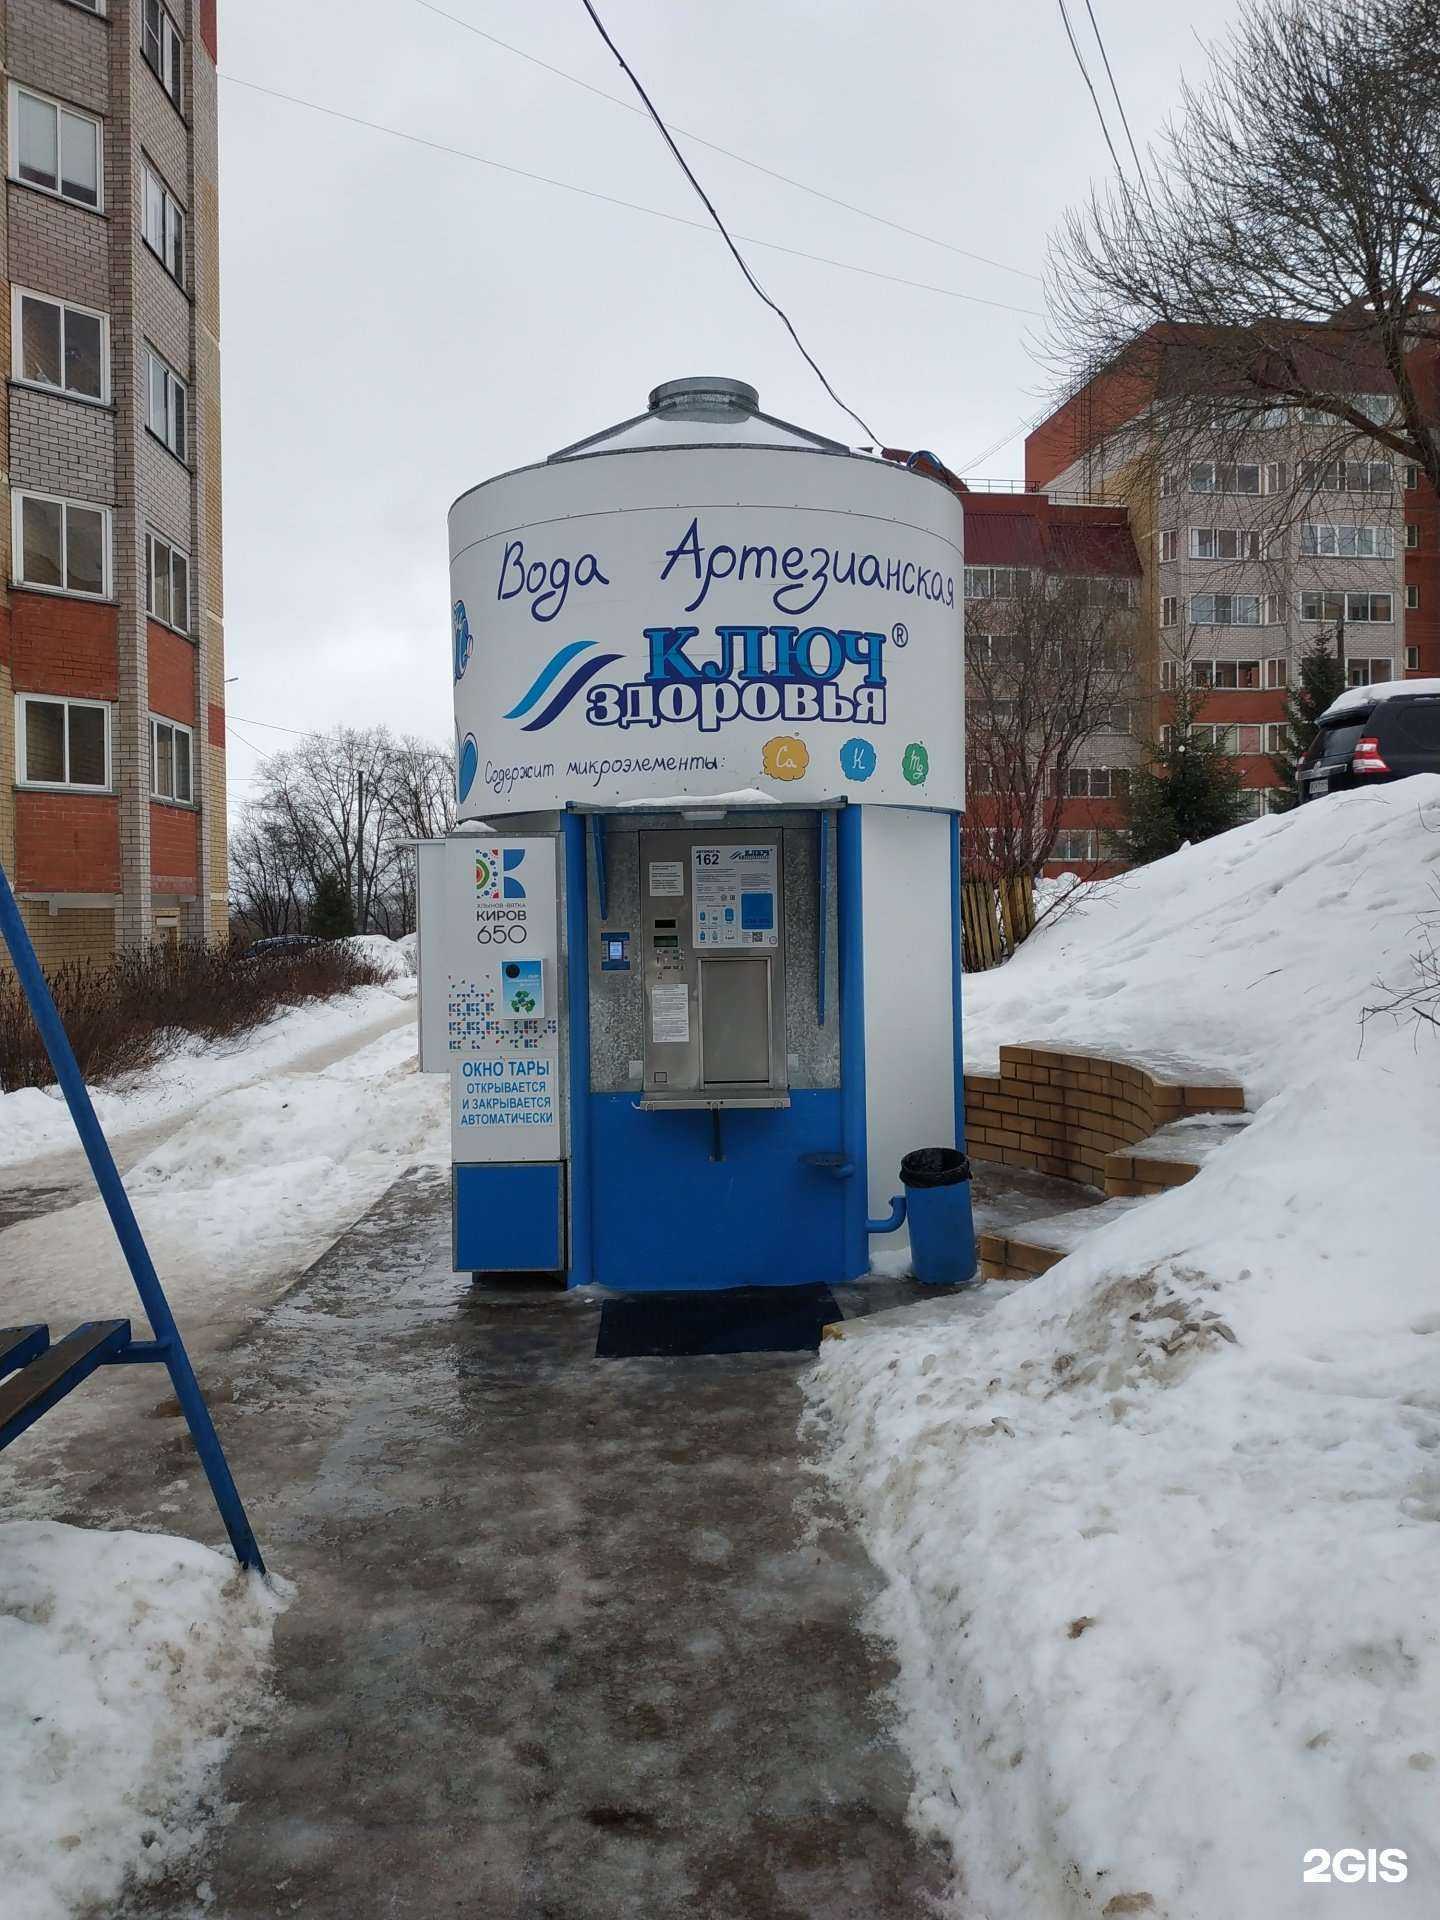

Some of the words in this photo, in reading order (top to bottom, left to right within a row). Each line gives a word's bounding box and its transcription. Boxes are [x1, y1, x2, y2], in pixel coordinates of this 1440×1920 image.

[497, 540, 609, 622] Вода
[660, 516, 955, 615] Артезианская
[484, 760, 555, 793] Содержит
[565, 755, 726, 787] микроэлементы:
[695, 853, 720, 866] 162
[476, 910, 527, 921] КИРОВ
[477, 925, 527, 944] 650
[462, 1061, 504, 1077] ОКНО
[508, 1060, 550, 1076] ТАРЫ
[466, 1081, 546, 1094] ОТКРЫВАЕТСЯ
[462, 1099, 470, 1110] И
[472, 1096, 551, 1110] ЗАКРЫВАЕТСЯ
[460, 1111, 553, 1126] АВТОМАТИЧЕСКИ
